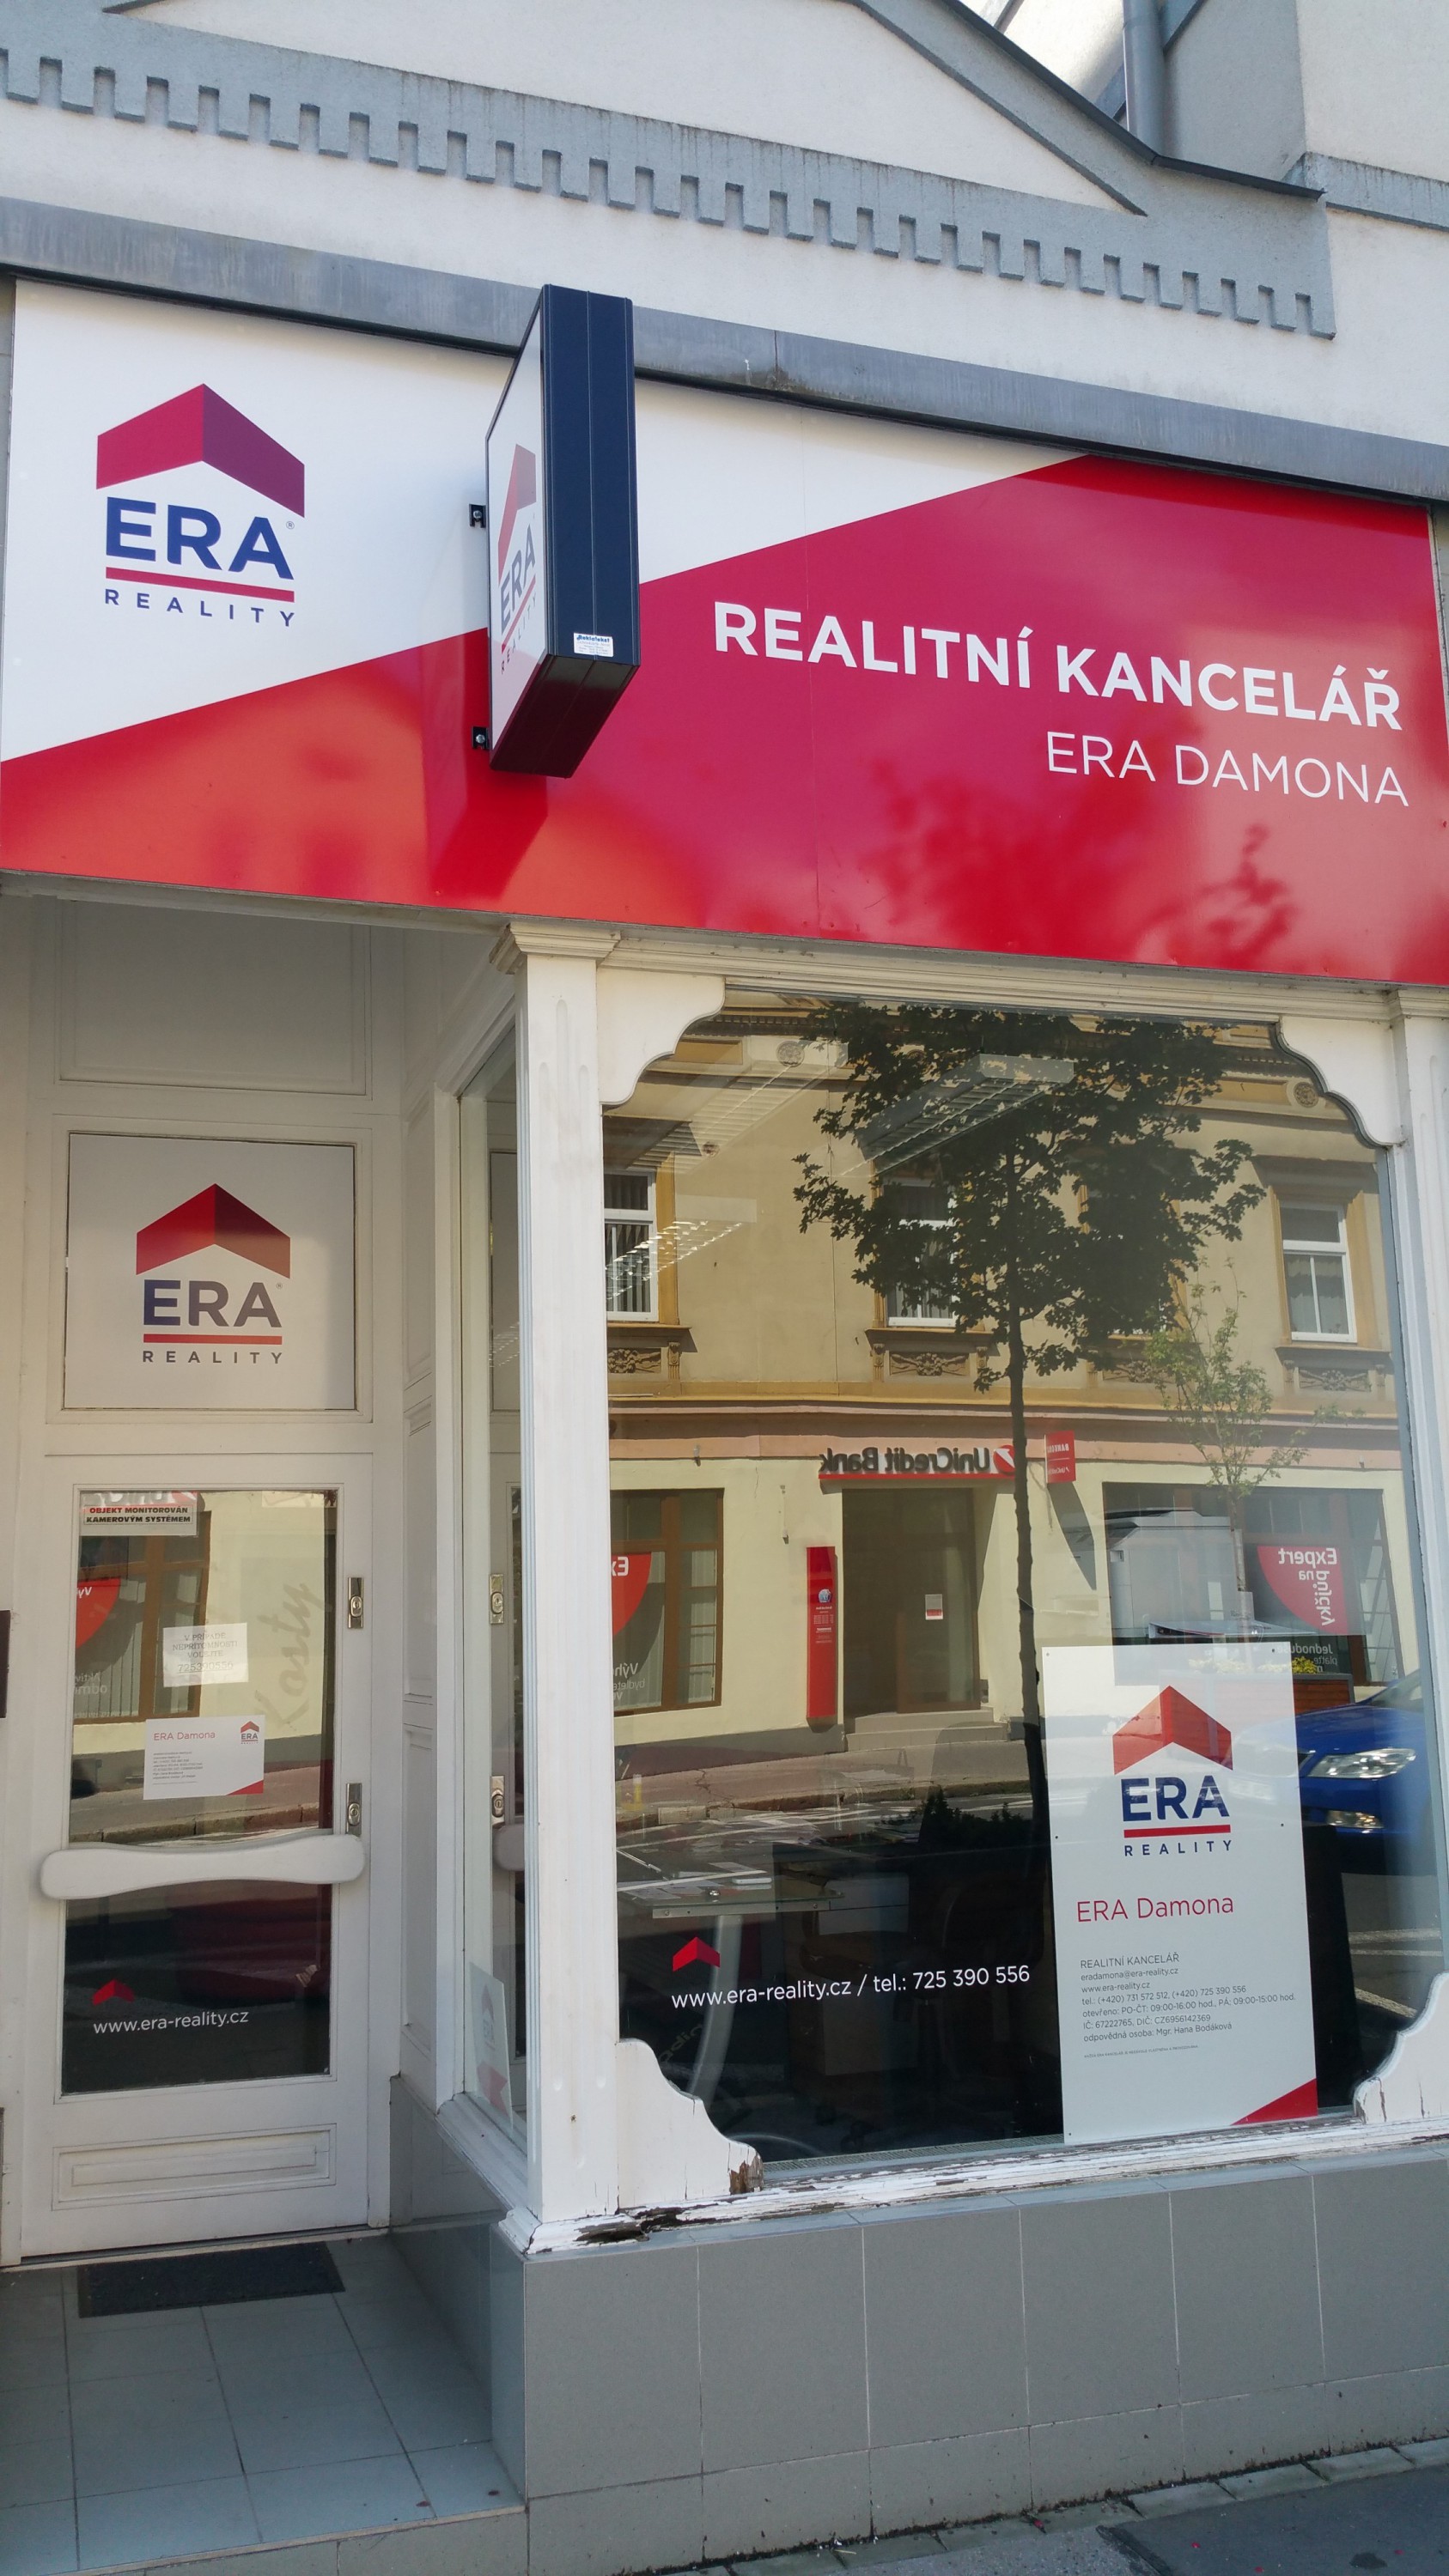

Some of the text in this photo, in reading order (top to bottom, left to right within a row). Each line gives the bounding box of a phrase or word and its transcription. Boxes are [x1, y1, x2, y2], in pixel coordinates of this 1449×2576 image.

[106, 496, 294, 580] ERA
[500, 523, 537, 635] ERA
[104, 588, 295, 628] REALITY
[501, 592, 537, 675] REALITY
[714, 600, 1403, 731] REALITNÍ KANCELÁŘ
[1047, 732, 1409, 808] ERA DAMONA
[143, 1279, 283, 1328] ERA
[142, 1350, 283, 1364] REALITY
[154, 1731, 216, 1741] ERA Damona
[1121, 1775, 1230, 1821] ERA
[1124, 1840, 1232, 1856] REALITY
[1077, 1897, 1233, 1923] ERA Damona
[1081, 1952, 1179, 1969] REALITNÍ KANCELÁŘ
[1081, 1967, 1178, 1981] eradamona@era-reality.cz
[672, 1965, 1031, 2008] www.era-reality.cz / tel.: 725 390 556
[1081, 1982, 1151, 1993] www.era-reality.cz
[1098, 1995, 1125, 2004] (+420)
[1127, 1993, 1139, 2002] 731
[1172, 1989, 1198, 2000] (+420)
[1201, 1988, 1214, 1996] 725
[1215, 1986, 1231, 1995] 390
[1233, 1985, 1246, 1994] 556
[1121, 2003, 1149, 2014] PO-ČT:
[1279, 1992, 1296, 2001] hod.
[93, 2011, 249, 2034] www.era-reality.cz
[1083, 2030, 1127, 2043] odpovědná
[1129, 2029, 1154, 2038] osoba:
[1156, 2027, 1172, 2037] Mgr.
[1195, 2021, 1233, 2032] Bodáková
[1095, 2018, 1134, 2029] 67222765,
[1136, 2015, 1153, 2026] DIČ:
[1154, 2014, 1211, 2025] CZ6956142369
